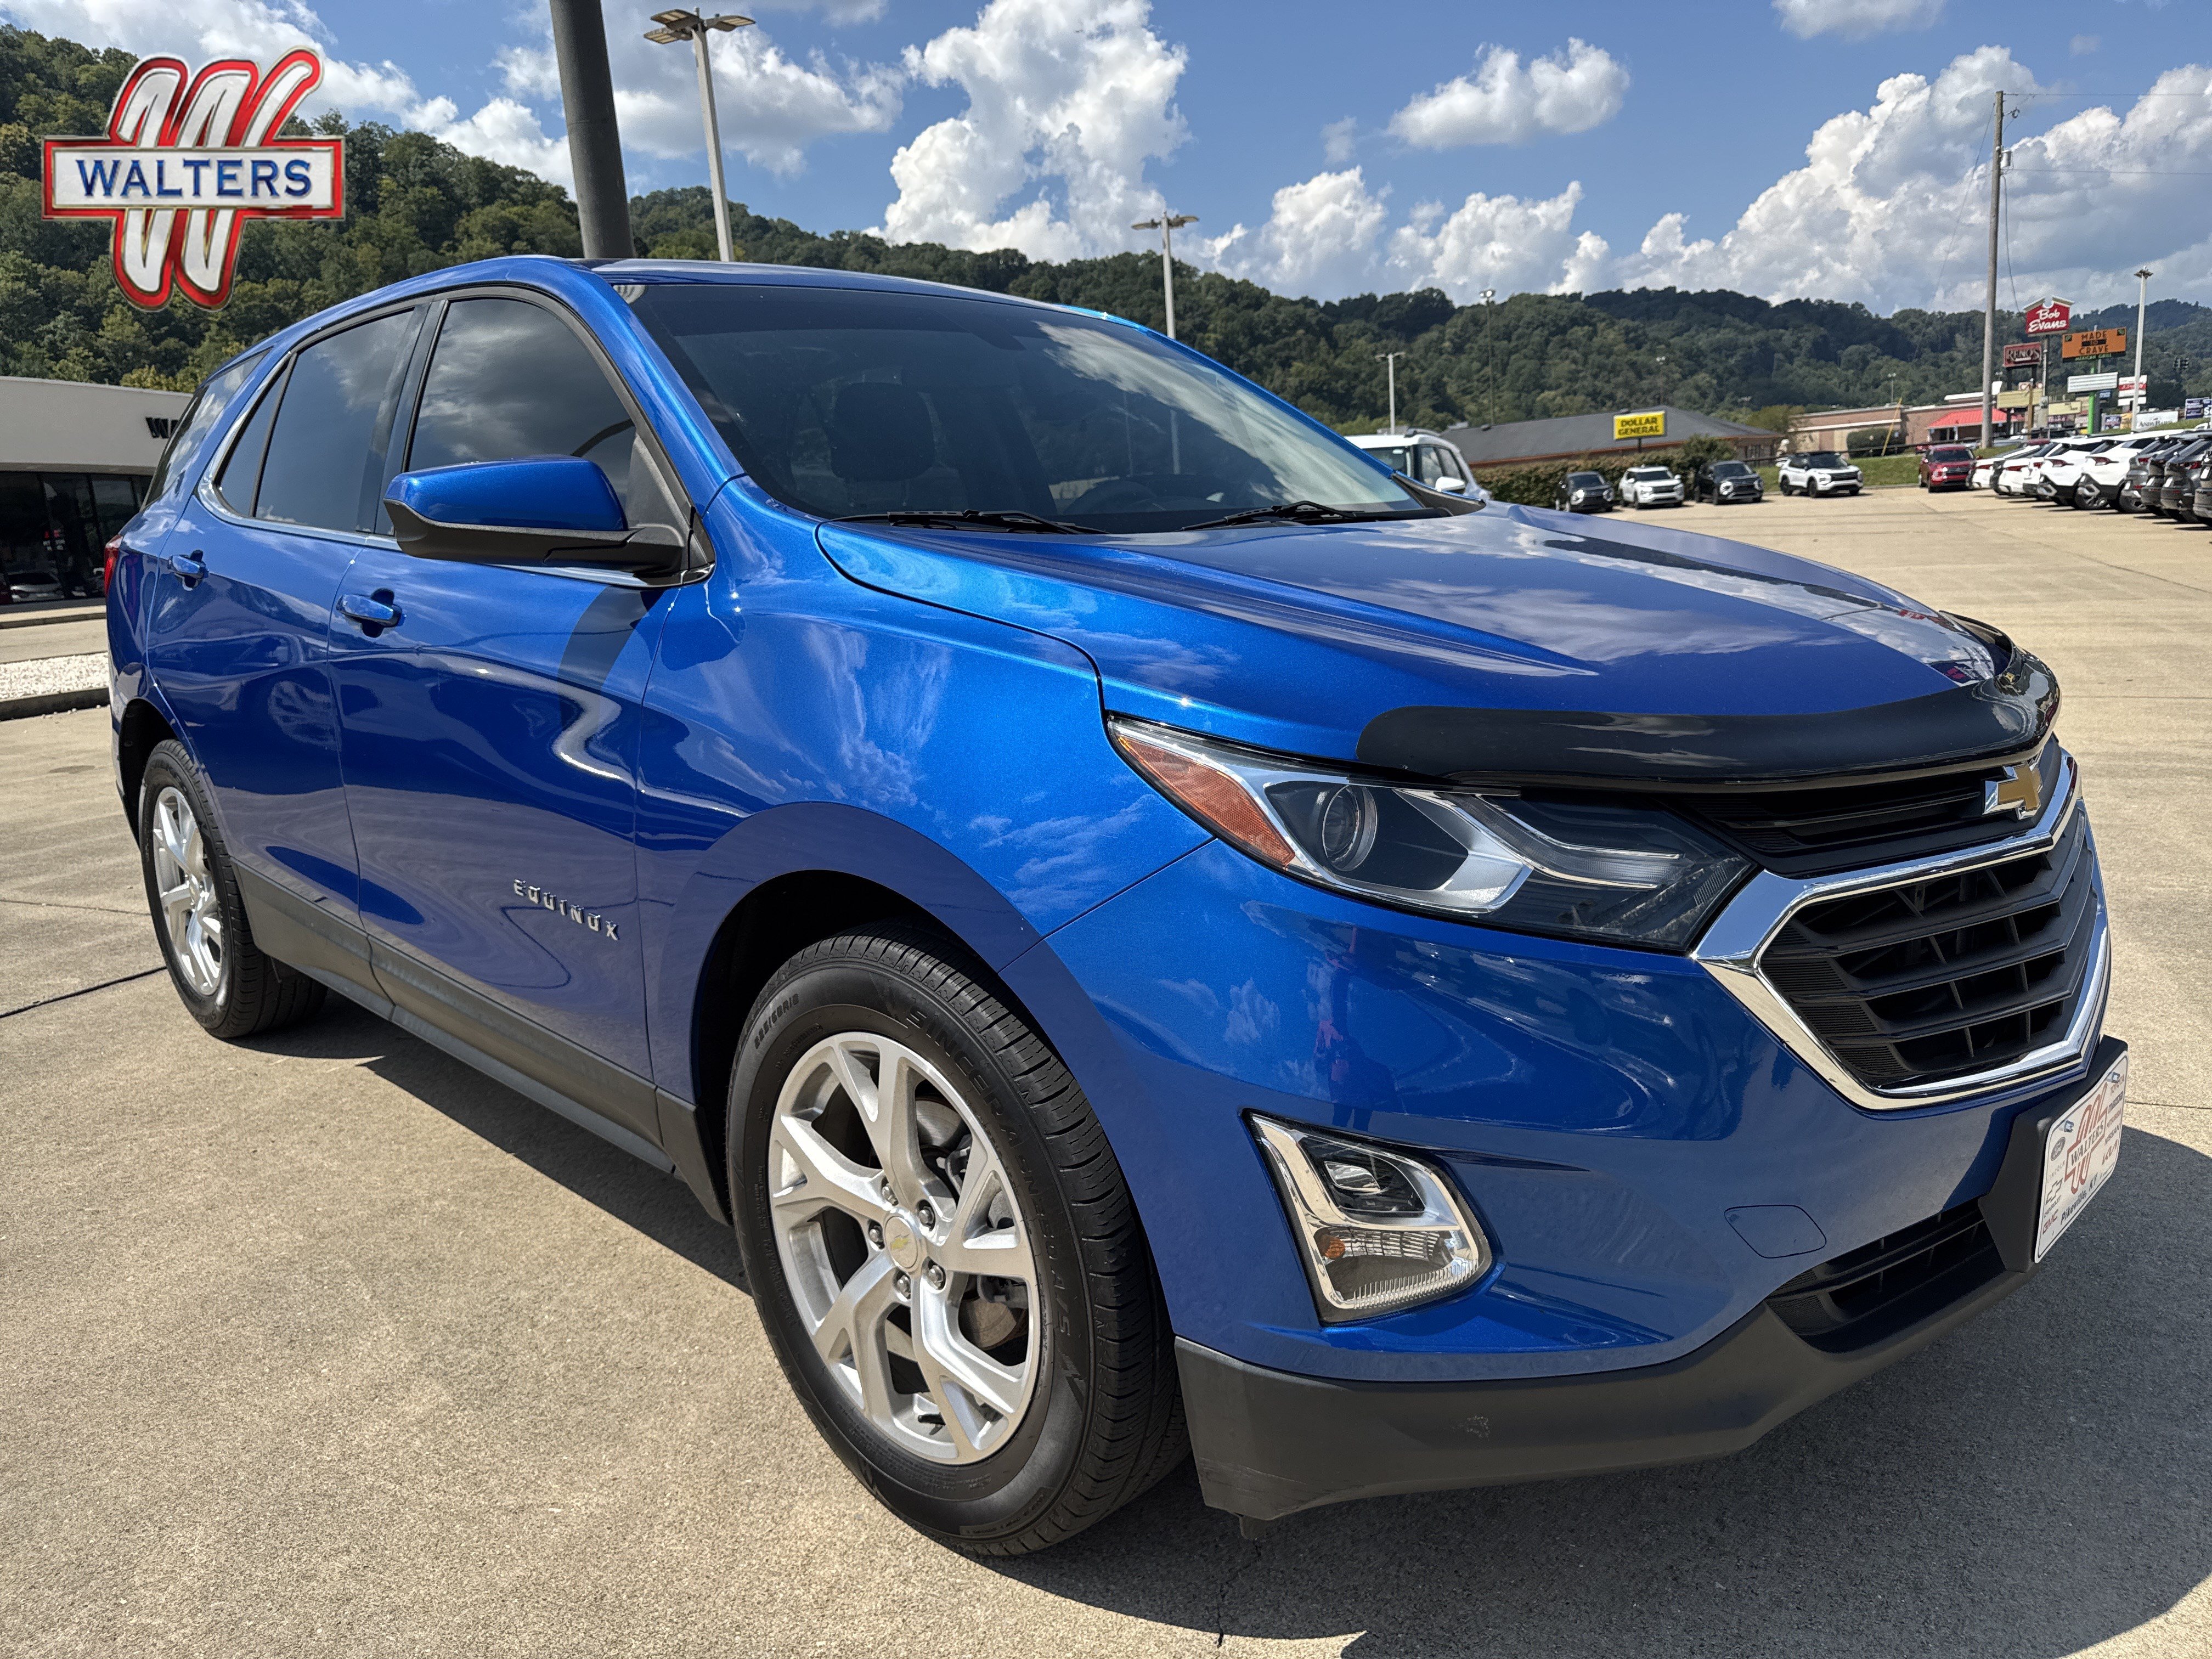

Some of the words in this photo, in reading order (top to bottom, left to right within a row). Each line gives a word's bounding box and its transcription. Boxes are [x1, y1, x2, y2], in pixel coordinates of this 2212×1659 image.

[2036, 308, 2061, 320] Bob
[2028, 318, 2067, 332] Evans
[2081, 330, 2107, 340] MADE
[2079, 345, 2109, 355] CRAVE
[1621, 417, 1657, 427] DOLLAR
[1618, 425, 1659, 436] GENERAL
[514, 879, 619, 941] EQUINOX
[2070, 1120, 2104, 1166] WALTERS
[2089, 1172, 2098, 1192] KY
[2042, 1209, 2058, 1235] GMC
